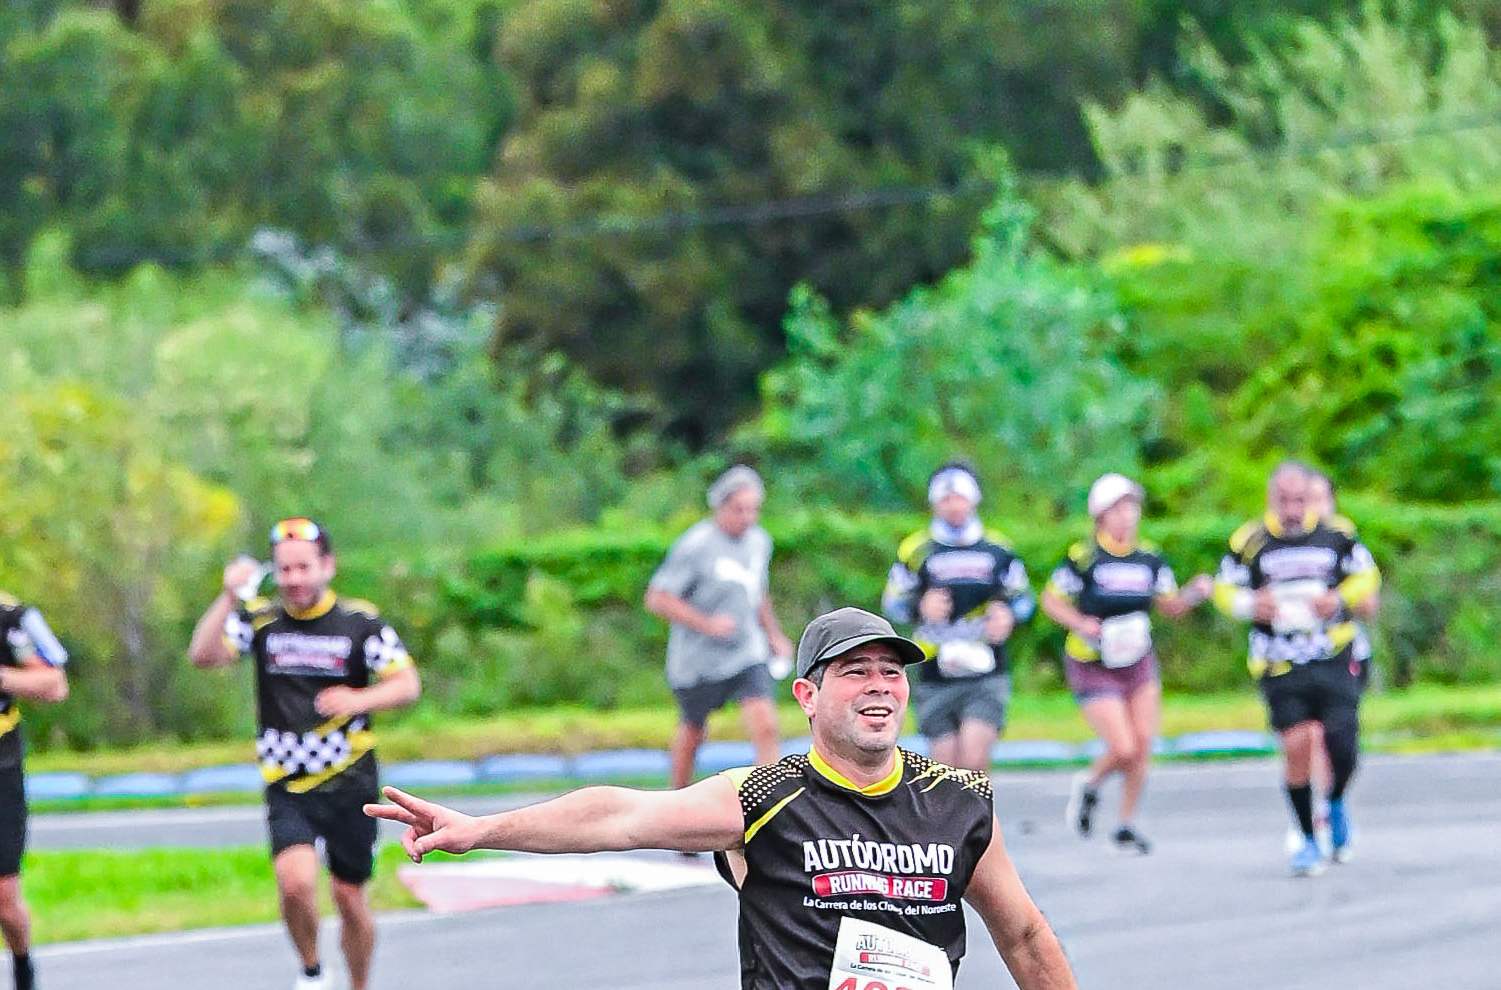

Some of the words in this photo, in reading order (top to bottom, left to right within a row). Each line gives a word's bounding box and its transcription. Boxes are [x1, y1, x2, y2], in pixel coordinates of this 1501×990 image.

[802, 833, 955, 874] AUTÓDROMO
[892, 880, 934, 899] RACE
[803, 896, 814, 907] La
[814, 899, 848, 910] Carrera
[849, 900, 862, 911] de
[863, 900, 877, 911] los
[904, 905, 920, 916] del
